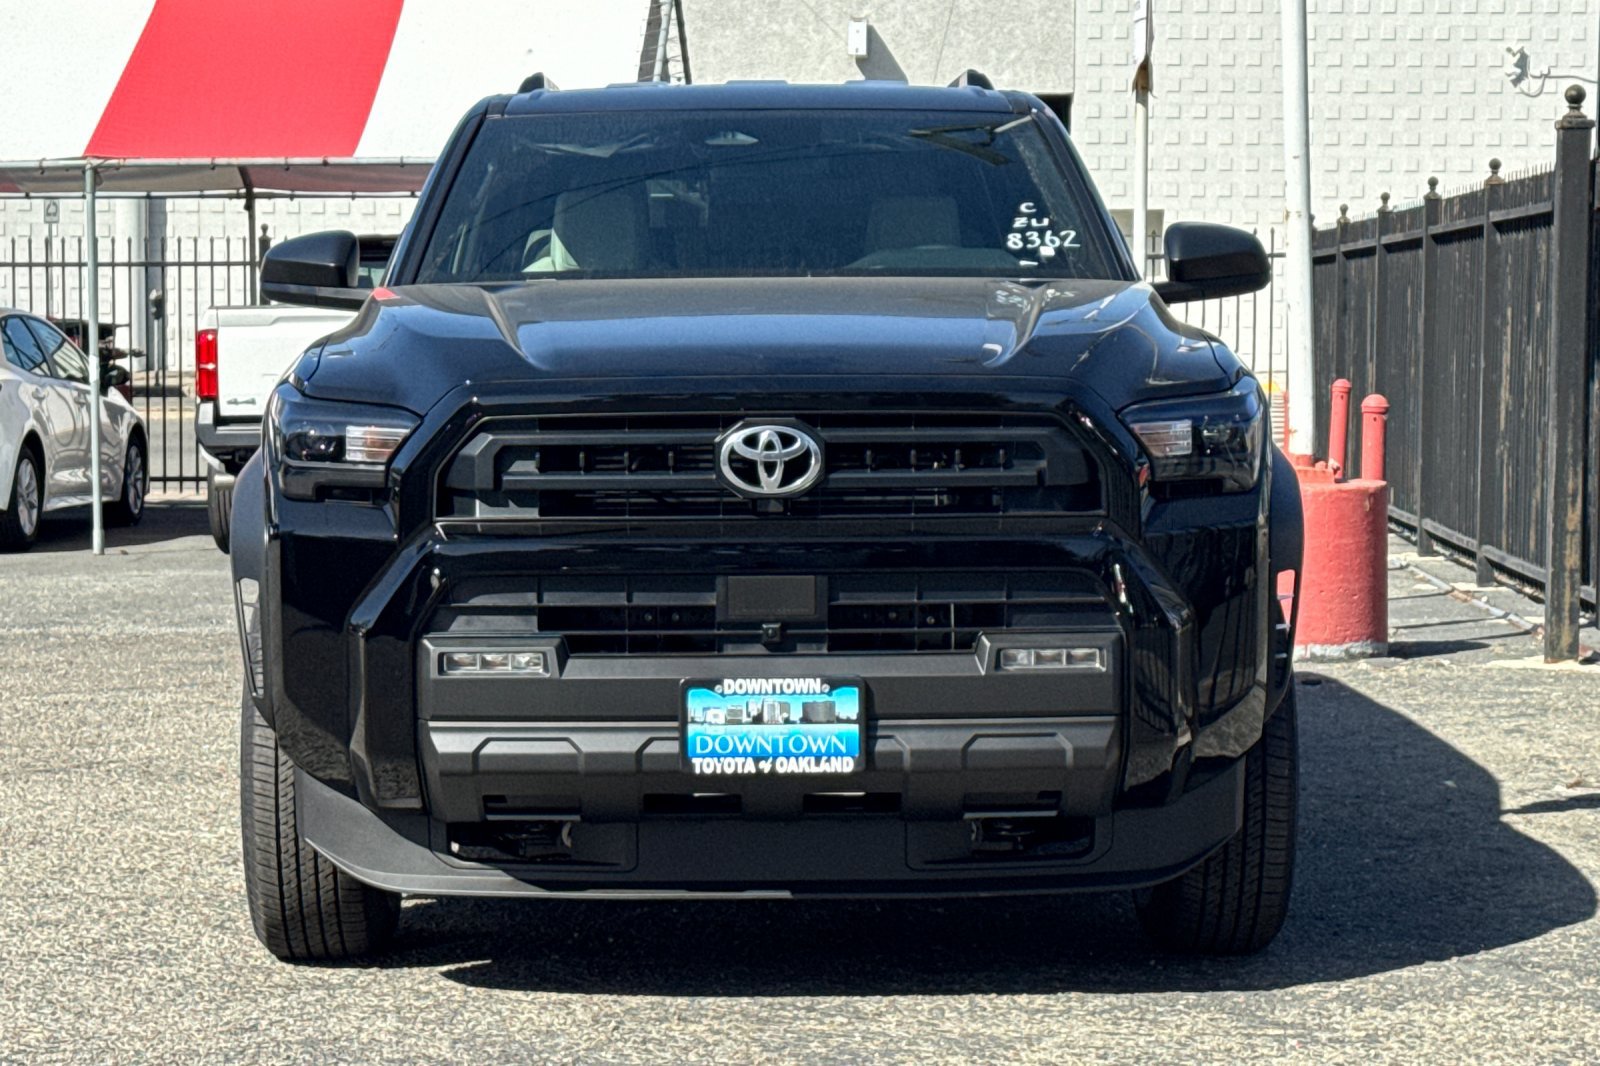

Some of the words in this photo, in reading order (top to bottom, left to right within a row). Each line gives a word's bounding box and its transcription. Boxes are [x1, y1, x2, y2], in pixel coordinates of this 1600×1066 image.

[1006, 230, 1081, 249] 8362
[723, 678, 821, 694] DOWNTOWN
[695, 735, 847, 754] DOWNTOWN
[692, 757, 756, 774] TOYOTA
[758, 758, 773, 774] of
[775, 757, 854, 773] OAKLAND
